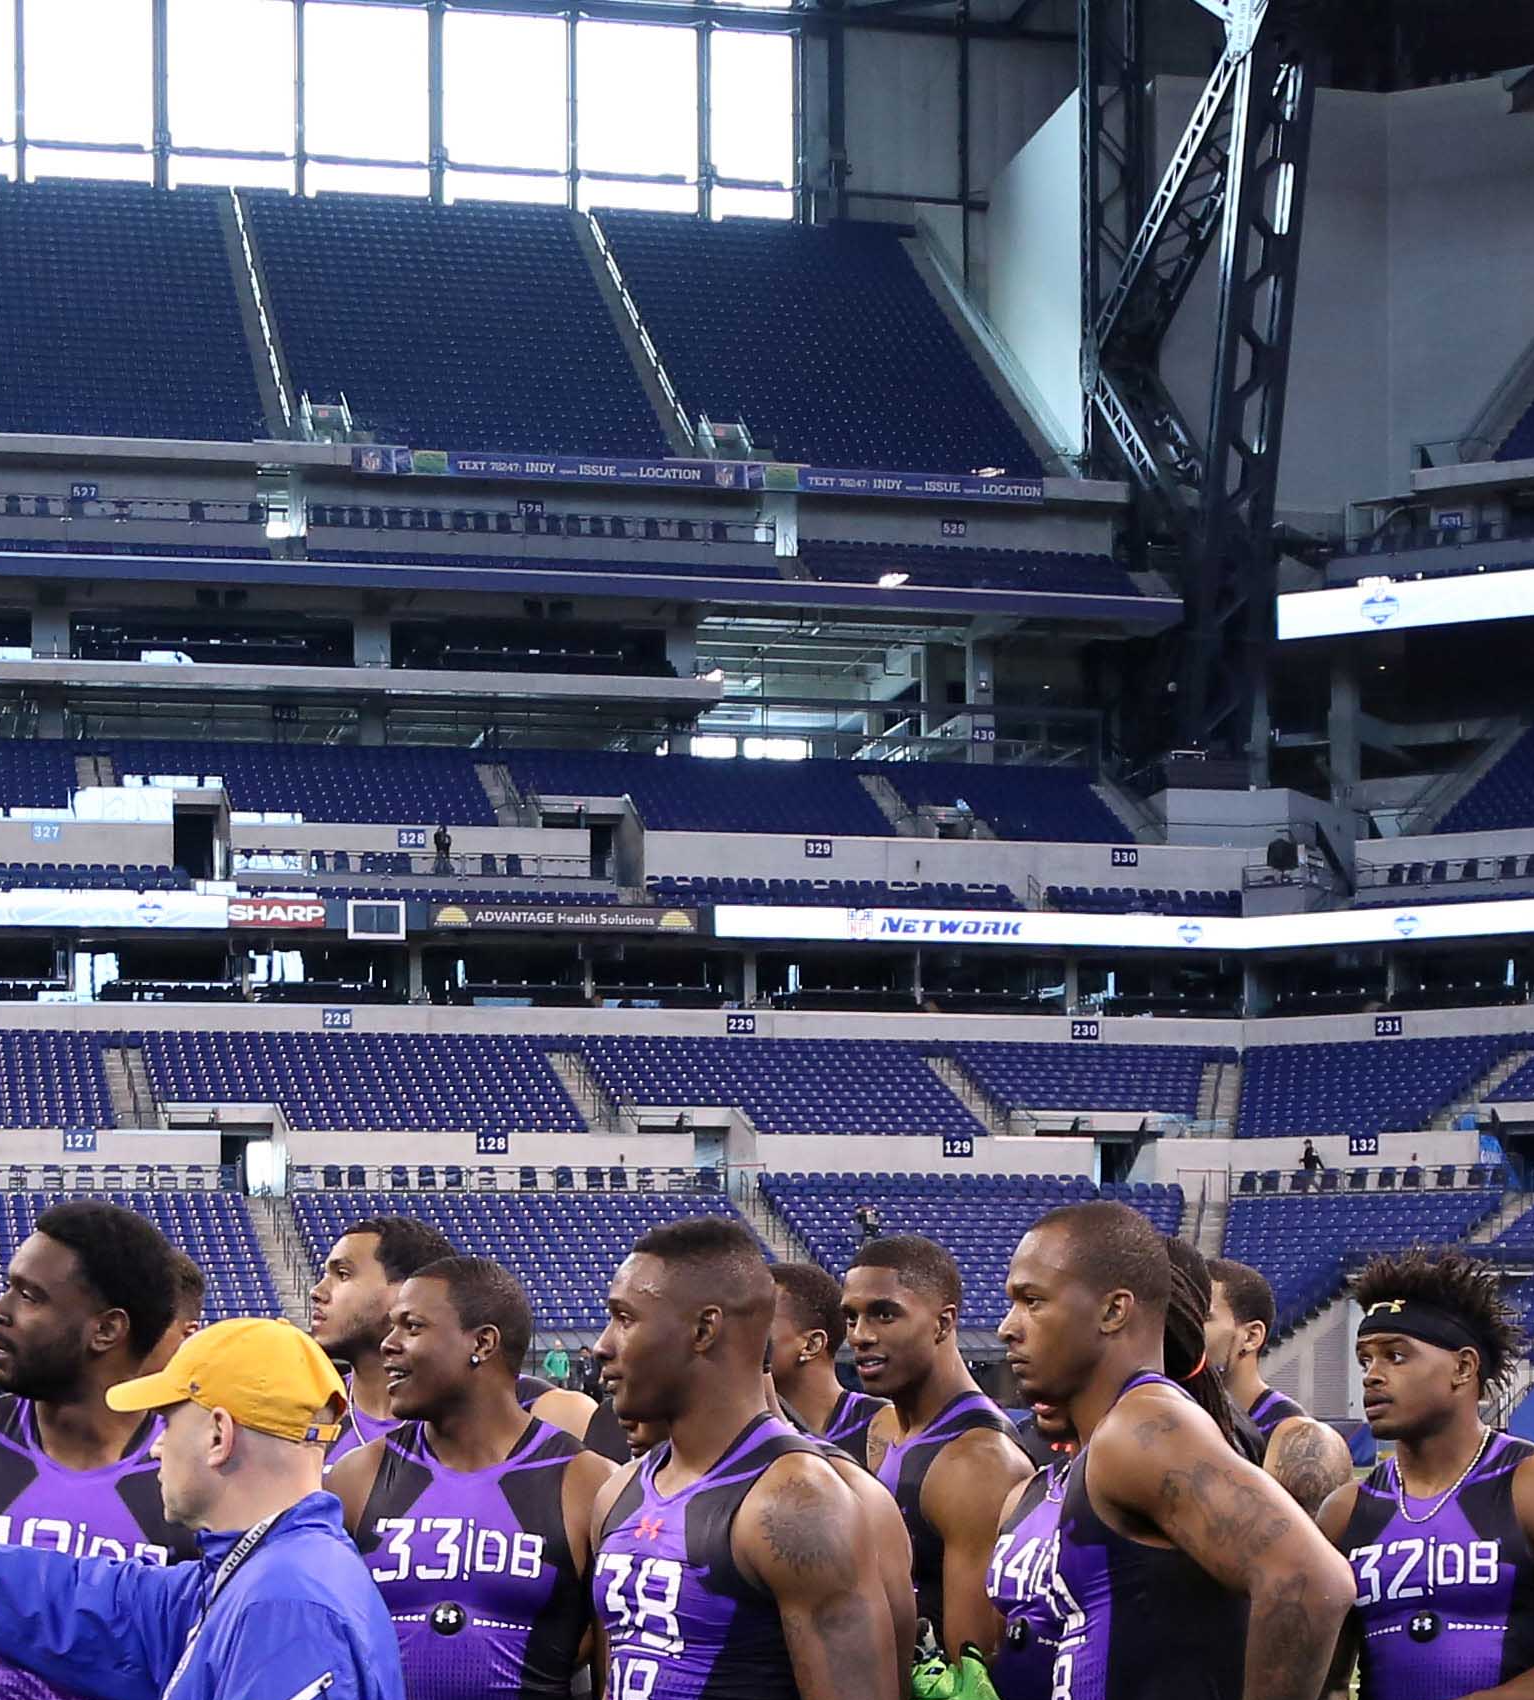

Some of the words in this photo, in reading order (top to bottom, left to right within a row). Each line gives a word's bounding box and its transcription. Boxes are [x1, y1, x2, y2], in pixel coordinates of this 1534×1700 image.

[458, 461, 487, 471] TEXT
[525, 462, 556, 474] INDY
[579, 465, 617, 477] ISSUE
[639, 466, 701, 481] LOCATION
[71, 484, 98, 498] 527
[808, 476, 835, 486] TEXT
[873, 478, 903, 491] INDY
[924, 481, 961, 493] ISSUE
[982, 484, 1041, 497] LOCATION
[943, 522, 965, 534] 529
[973, 729, 996, 742] 430
[32, 824, 60, 839] 327
[398, 831, 425, 846] 328
[806, 841, 832, 856] 329
[1111, 850, 1138, 866] 330
[228, 905, 323, 922] SHARP
[475, 911, 554, 924] ADVANTAGE
[558, 912, 597, 925] Health
[600, 913, 655, 927] Solutions
[880, 916, 1023, 937] NETWORK
[325, 1011, 351, 1026] 228
[728, 1018, 754, 1031] 229
[1073, 1024, 1098, 1037] 230
[1377, 1019, 1401, 1034] 231
[66, 1134, 93, 1148] 127
[478, 1137, 507, 1152] 128
[944, 1139, 973, 1155] 129
[1351, 1139, 1377, 1152] 132
[223, 1522, 268, 1573] adidas
[372, 1517, 463, 1581] 33
[475, 1529, 545, 1579] DB
[986, 1534, 1041, 1601] 34
[1350, 1539, 1426, 1606] 32
[1436, 1541, 1500, 1585] DB
[596, 1553, 686, 1655] 38
